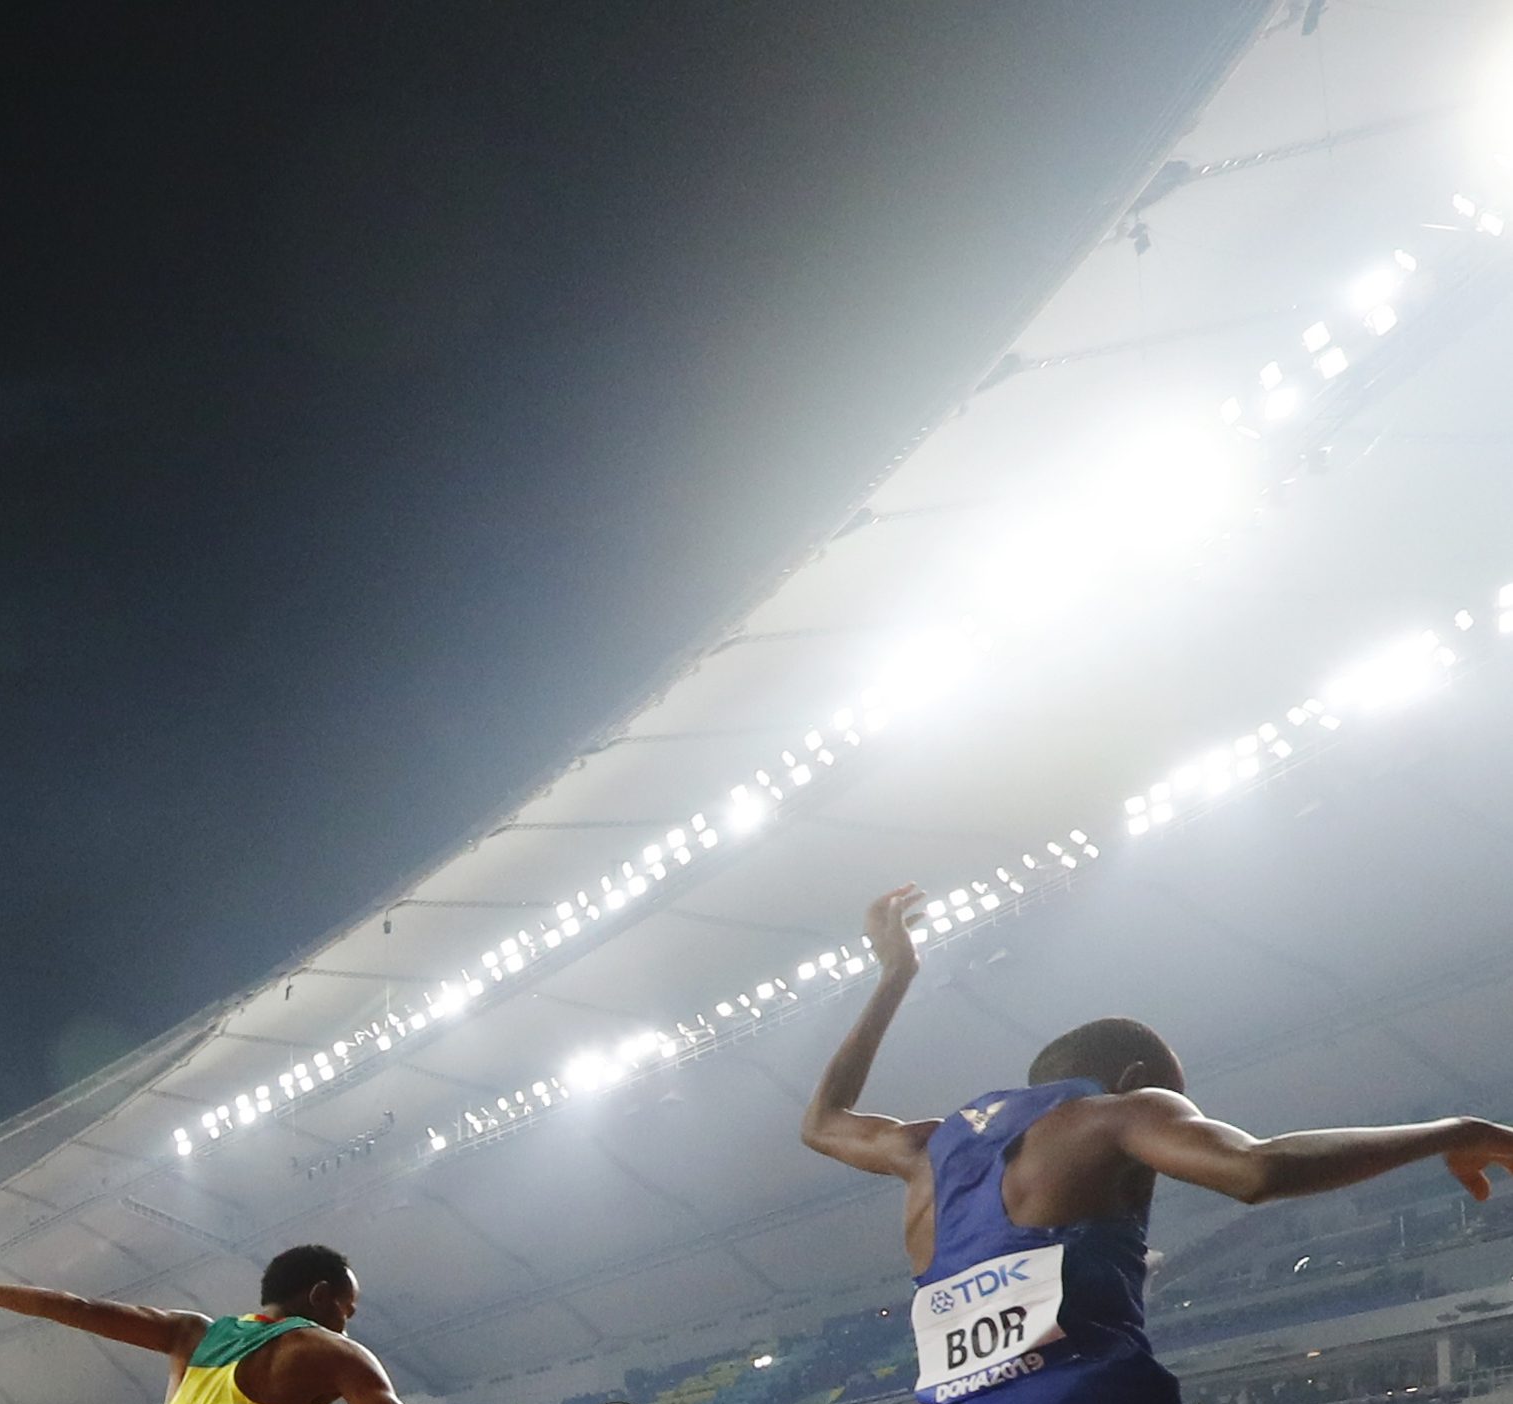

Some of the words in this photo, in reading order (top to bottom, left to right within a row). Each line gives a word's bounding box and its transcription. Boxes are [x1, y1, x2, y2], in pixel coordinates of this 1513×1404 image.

[952, 1258, 1031, 1304] TDK
[946, 1305, 1028, 1371] BOR
[935, 1351, 1045, 1404] DOHA2019
